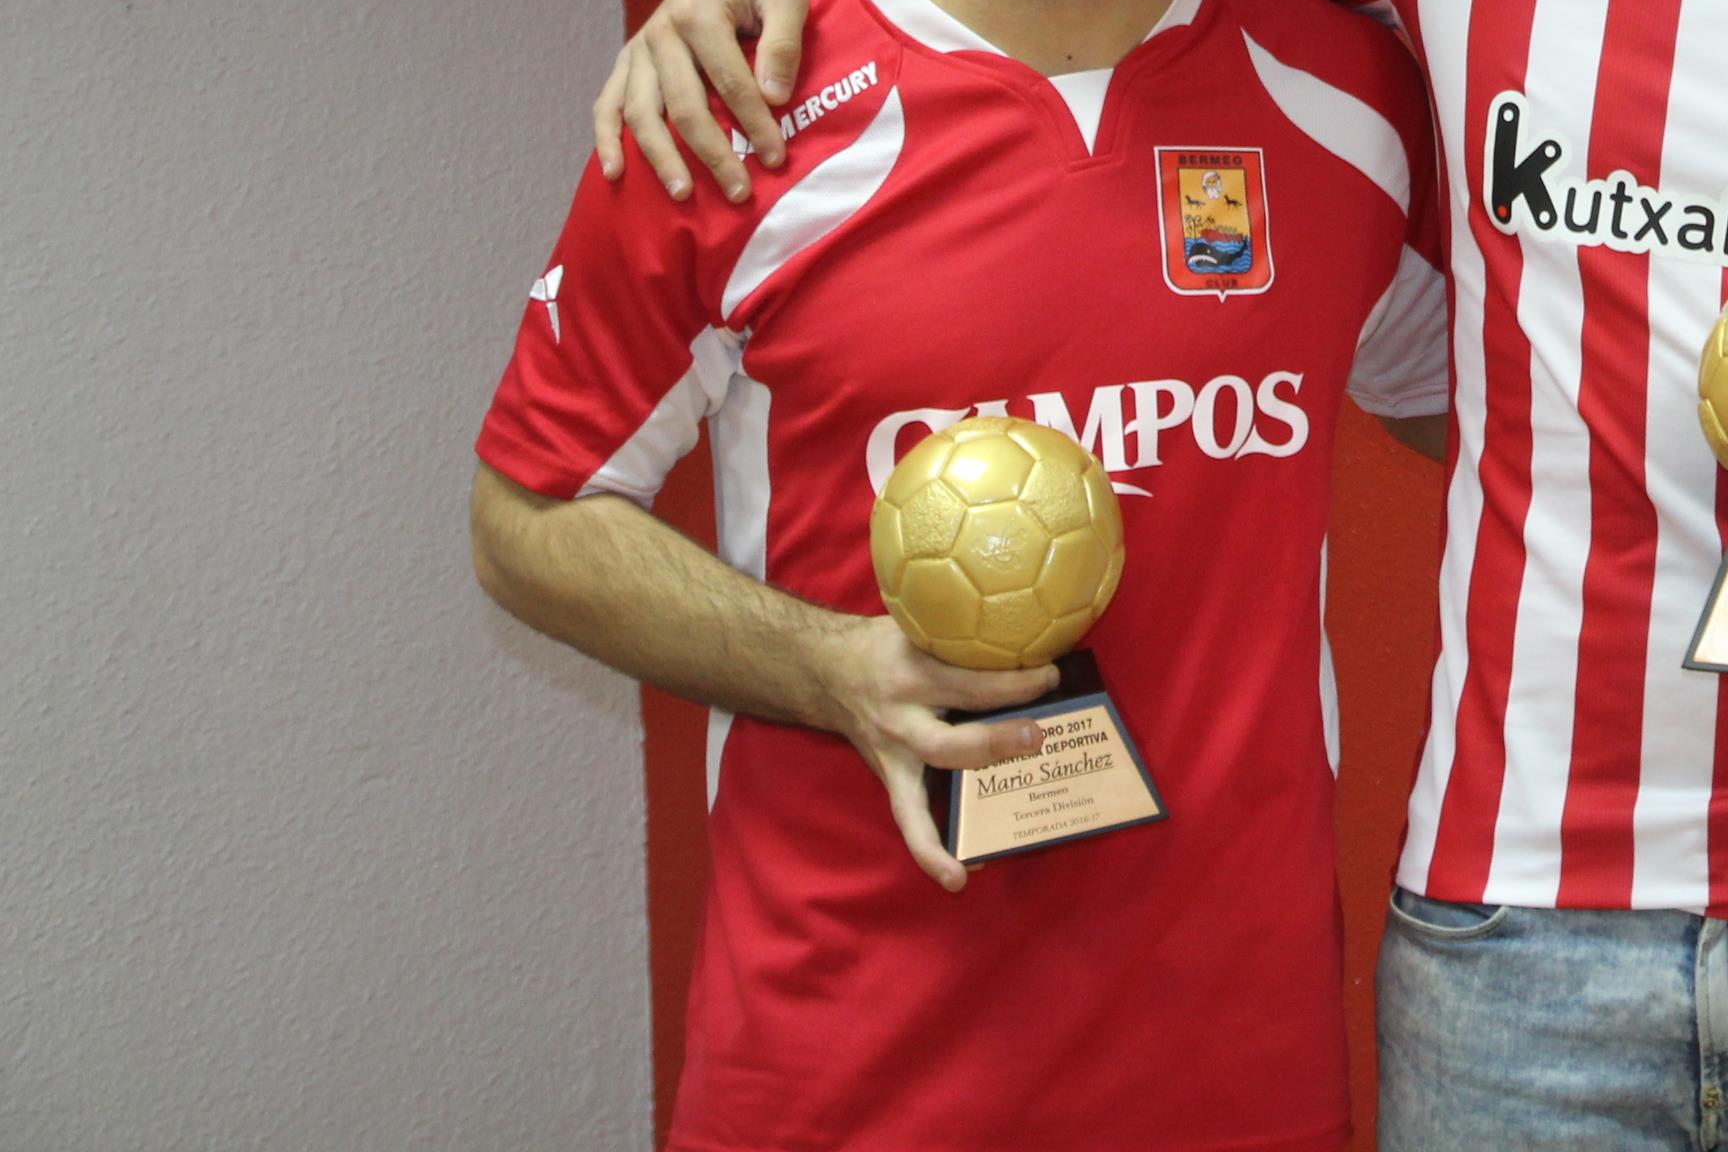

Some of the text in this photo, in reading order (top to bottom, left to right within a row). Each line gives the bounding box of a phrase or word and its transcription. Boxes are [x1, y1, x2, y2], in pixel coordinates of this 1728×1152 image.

[1178, 154, 1242, 166] BERMEO
[1206, 278, 1238, 288] CLUB
[866, 370, 1310, 497] CMPOS
[1041, 718, 1093, 740] ORO 2017
[1045, 731, 1109, 755] DEPORTIVA
[977, 769, 1033, 797] Mario
[1039, 751, 1113, 783] Sánchez
[1028, 786, 1069, 802] Bermeo
